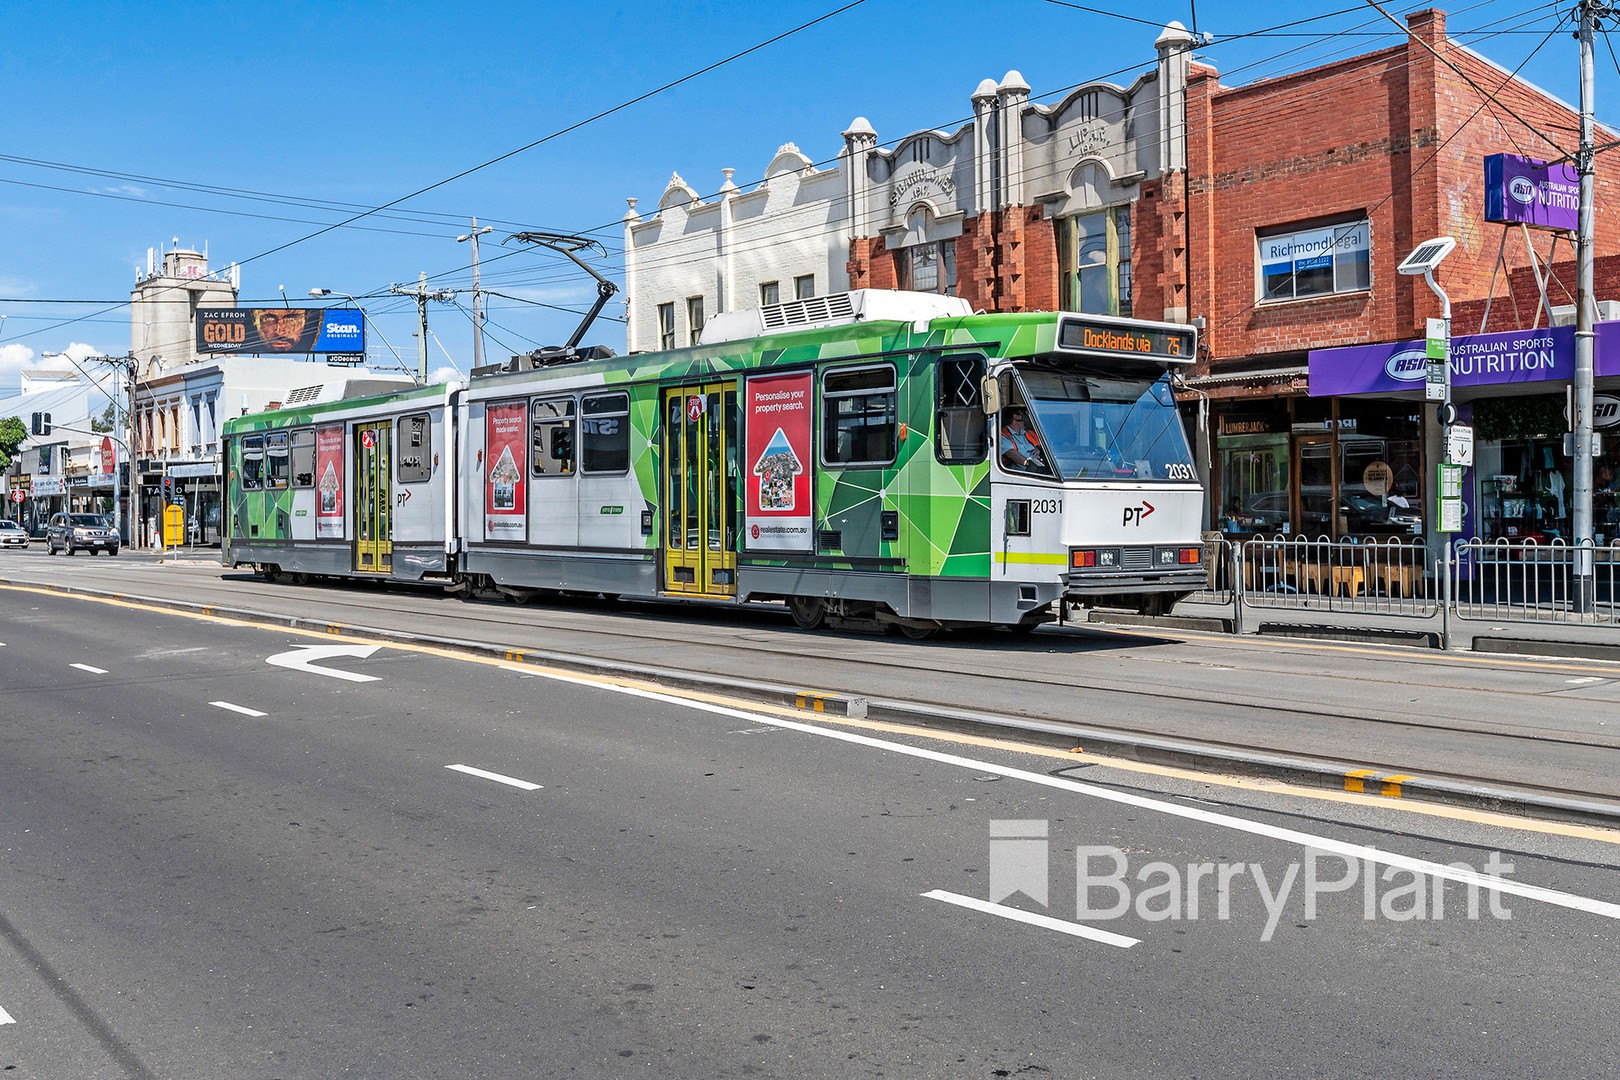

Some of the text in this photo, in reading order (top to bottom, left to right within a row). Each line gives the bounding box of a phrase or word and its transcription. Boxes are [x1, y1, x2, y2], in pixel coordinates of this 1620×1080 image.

[1513, 183, 1532, 195] ASN
[1538, 180, 1579, 194] AUSTRALIAN SPOR
[1538, 189, 1579, 211] NUTRITIO
[204, 323, 245, 343] GOLD
[1083, 328, 1180, 355] Docklands via 75
[1449, 337, 1554, 356] USTRALIAN SPORTS
[1450, 349, 1555, 376] NUTRITION
[689, 398, 700, 406] STOP
[755, 389, 805, 402] Personalise your
[755, 401, 804, 414] property search.
[492, 417, 508, 425] Property
[1225, 421, 1265, 434] LUMBERJACK
[1164, 463, 1195, 480] 2031
[1033, 499, 1063, 514] 2031
[760, 526, 807, 534] realestate.com.au
